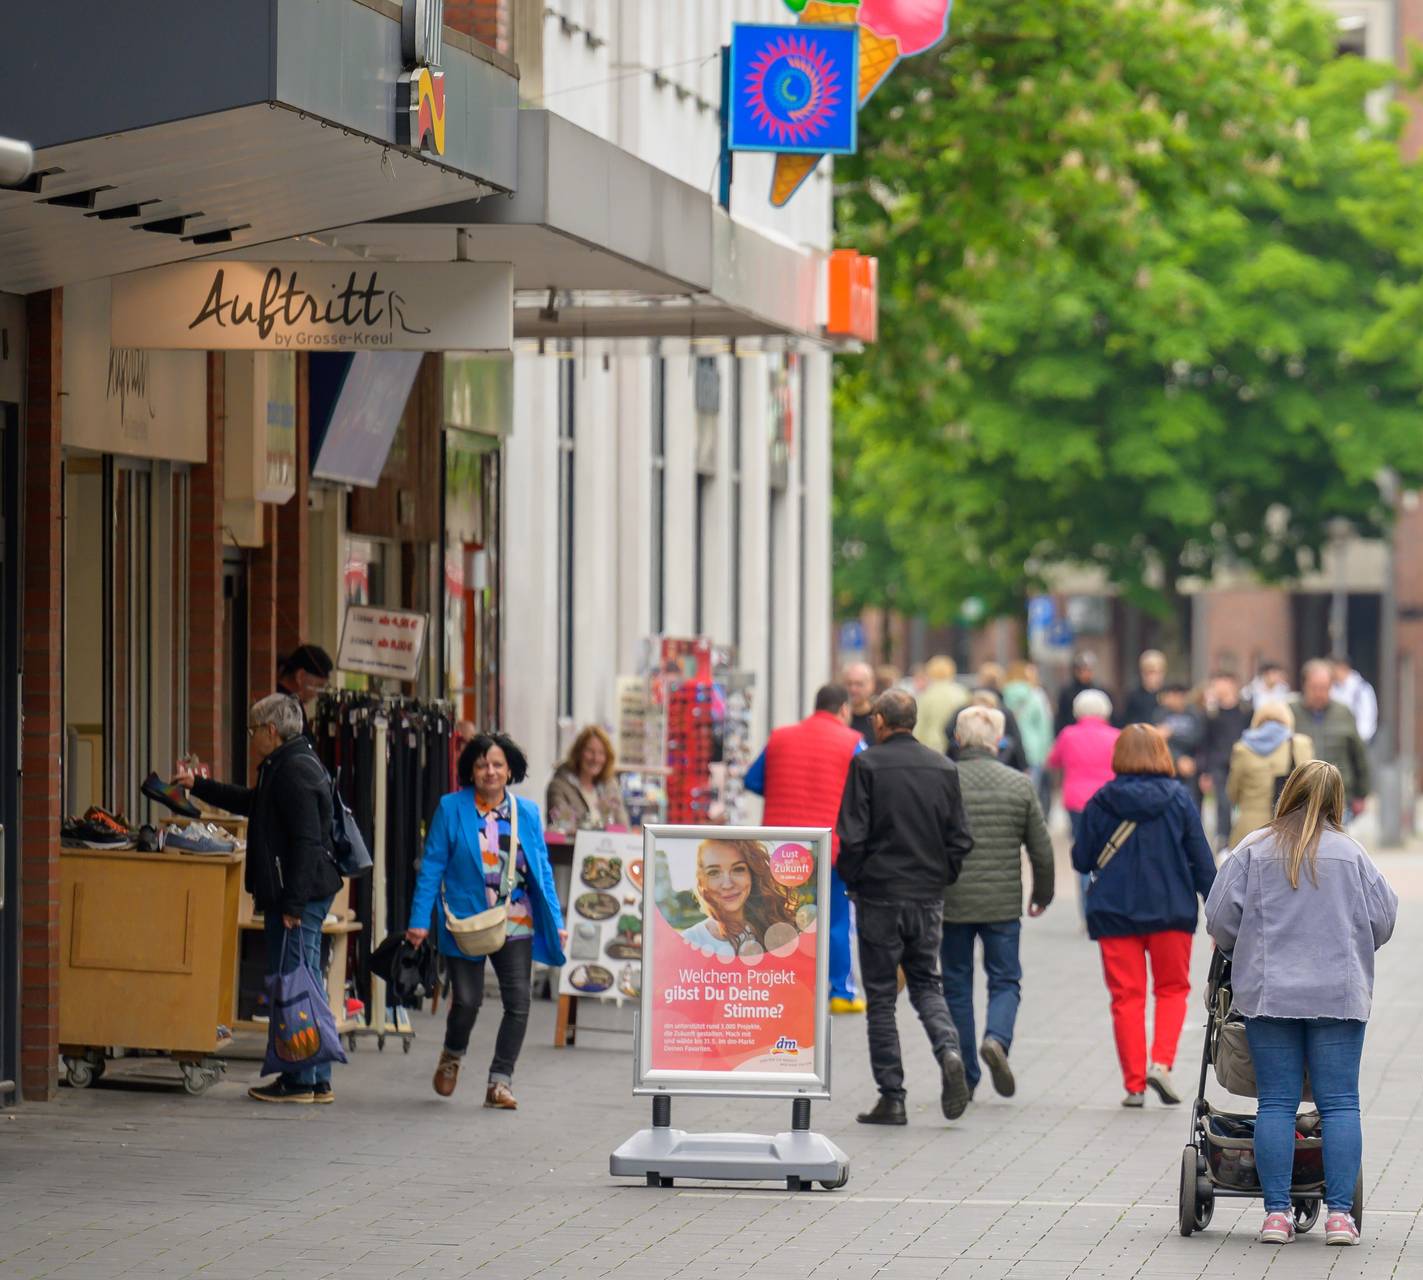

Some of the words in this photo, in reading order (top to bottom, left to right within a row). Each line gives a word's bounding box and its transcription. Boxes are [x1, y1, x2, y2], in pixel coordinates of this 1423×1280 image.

[188, 267, 385, 340] Auftritt
[274, 333, 293, 347] by
[296, 332, 393, 345] Grosse-Kreul
[781, 850, 799, 858] Lust
[774, 864, 809, 873] Zukunft
[679, 969, 741, 984] Welchem
[747, 969, 796, 987] Projekt
[664, 986, 699, 1004] gibst
[704, 987, 724, 1001] Du
[729, 987, 770, 1001] Deine
[723, 1003, 784, 1018] Stimme?
[776, 1037, 796, 1049] dm
